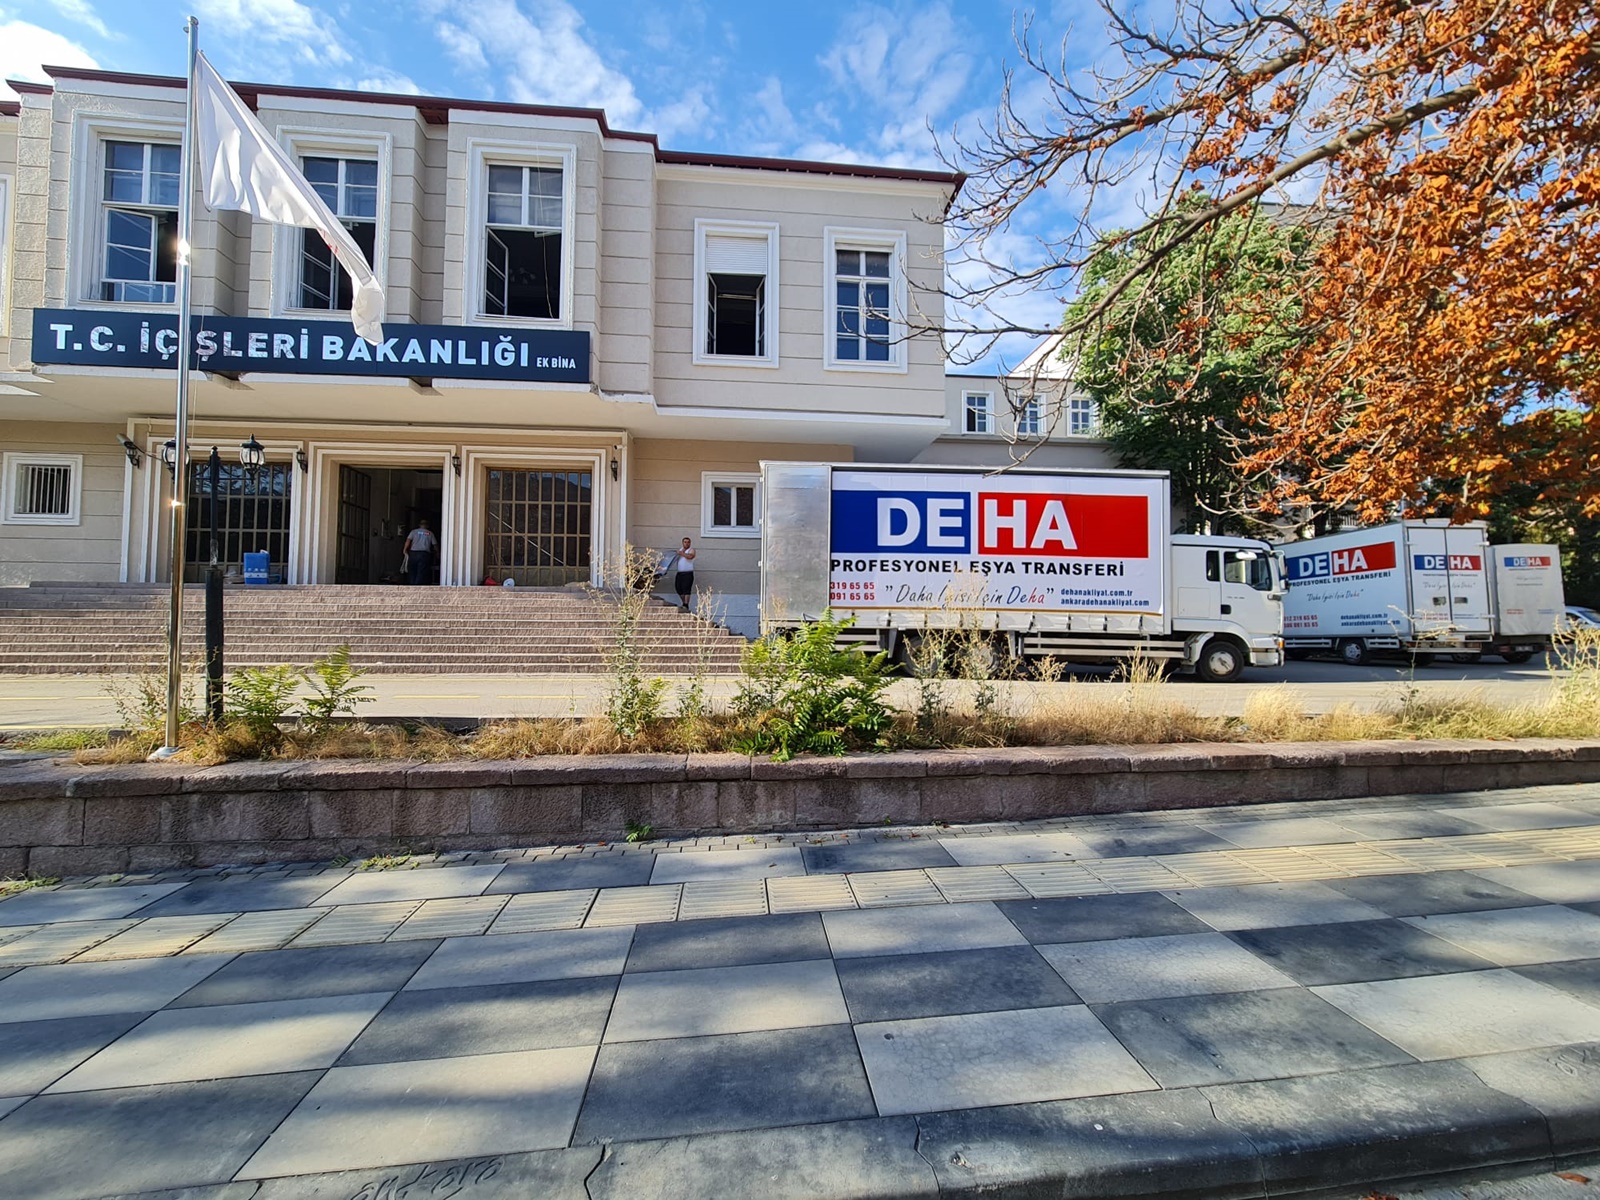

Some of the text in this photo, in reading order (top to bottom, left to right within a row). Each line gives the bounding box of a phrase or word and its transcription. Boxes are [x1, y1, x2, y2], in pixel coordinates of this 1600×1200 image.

[140, 321, 308, 362] İÇŞLERİ
[322, 335, 529, 367] BAKANLIĞI
[536, 357, 549, 368] EK
[551, 355, 576, 369] BİNA
[877, 497, 1078, 550] DEHA
[1299, 549, 1368, 577] DEHA
[1424, 556, 1473, 569] DEHA
[1513, 558, 1542, 566] DEHA
[831, 559, 1124, 577] PROFESYONEL EŞYA TRANSFERİ
[1352, 571, 1391, 580] TRANSFERİ
[850, 582, 861, 590] 65
[864, 582, 875, 590] 65
[1061, 588, 1133, 597] dehanakliyat.com.tr
[1061, 598, 1149, 607] ankaradehanakliyat.com
